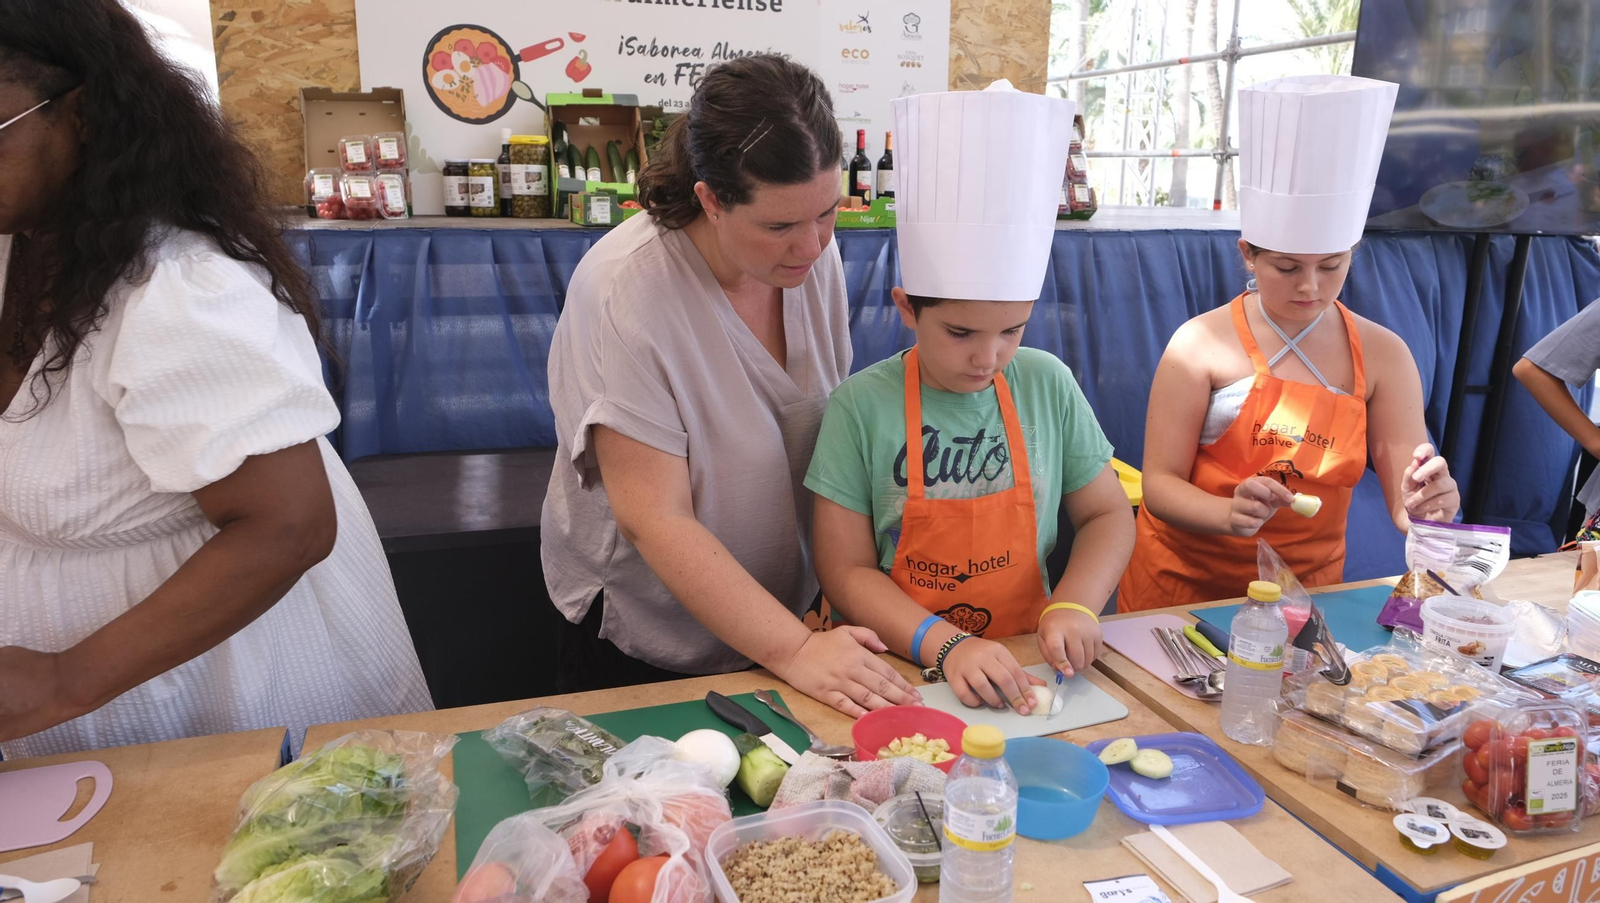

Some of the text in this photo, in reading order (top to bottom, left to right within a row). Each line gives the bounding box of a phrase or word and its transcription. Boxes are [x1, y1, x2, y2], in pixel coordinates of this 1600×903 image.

[628, 0, 783, 12] eriense
[841, 48, 870, 60] eco
[644, 62, 716, 87] en FE
[658, 98, 672, 108] del
[673, 100, 683, 108] 23
[1252, 420, 1336, 450] hogar hotel
[1252, 436, 1293, 449] hoalve
[893, 424, 1009, 488] Auto
[906, 550, 1010, 578] hogar hotel
[909, 573, 957, 592] hoalve
[1435, 635, 1451, 648] FRITA
[1546, 758, 1570, 767] FERIA
[1552, 768, 1563, 776] DE
[1547, 779, 1573, 788] ALMERIA
[1551, 792, 1568, 801] 2025
